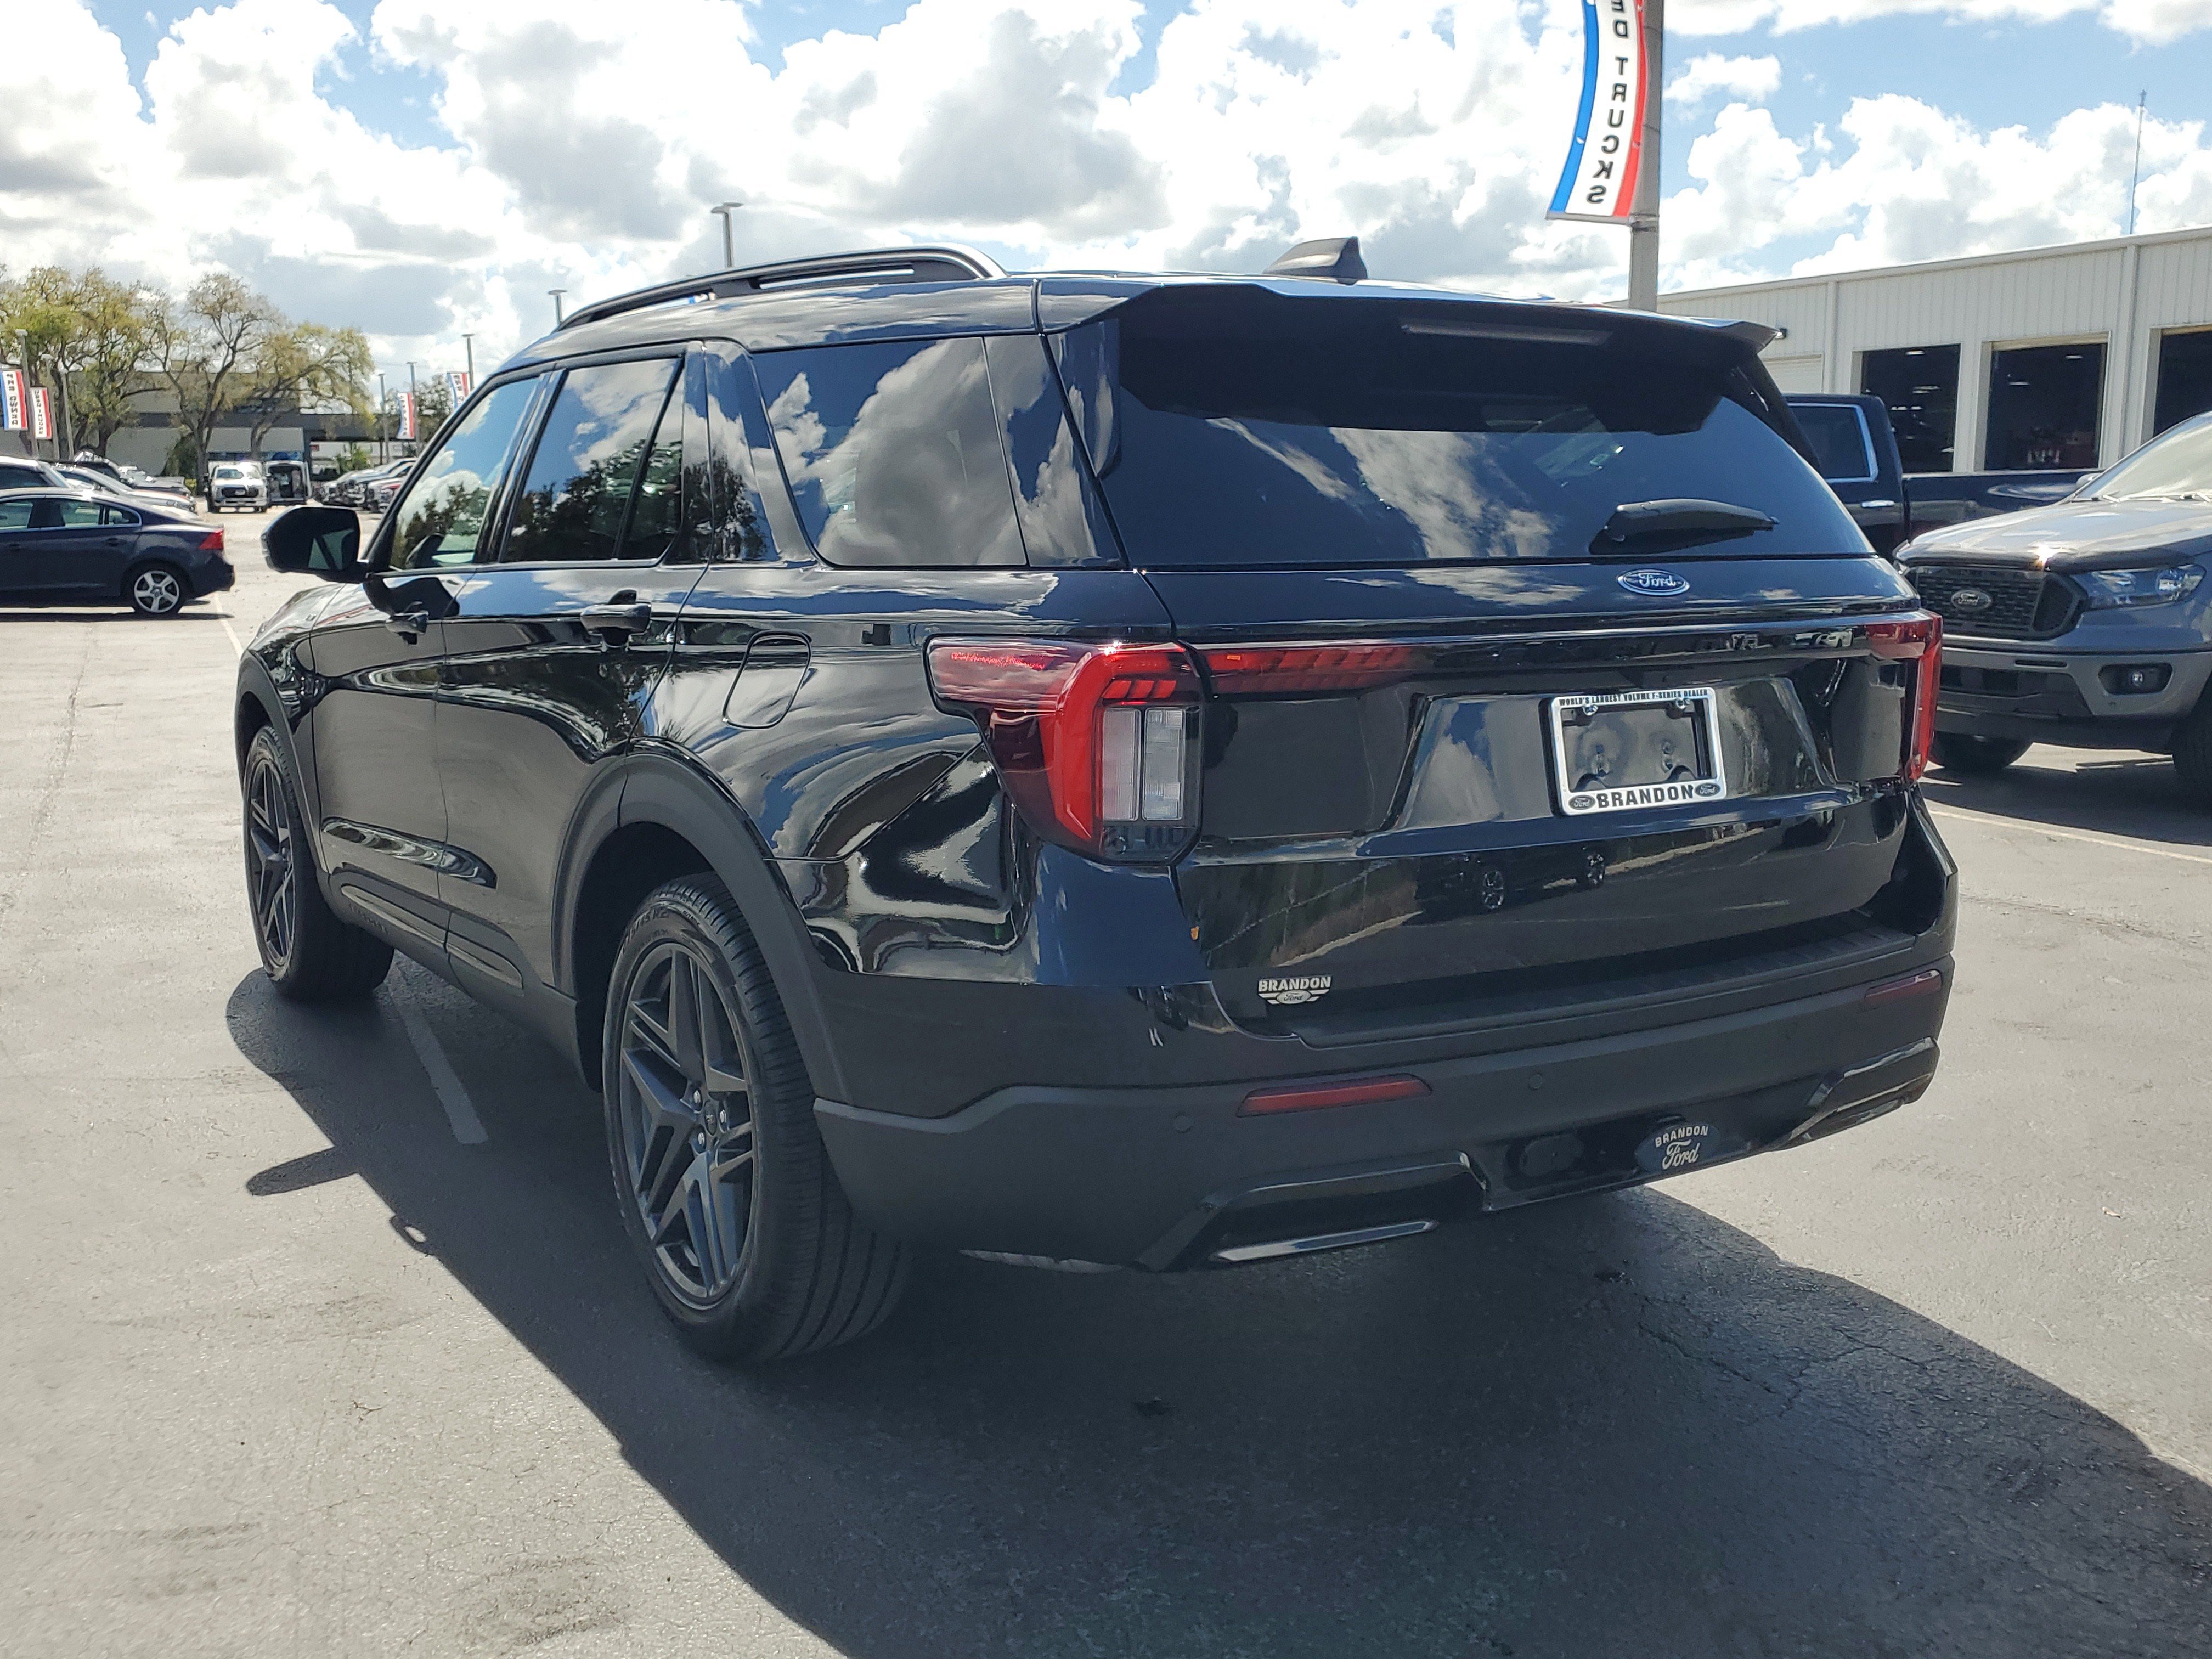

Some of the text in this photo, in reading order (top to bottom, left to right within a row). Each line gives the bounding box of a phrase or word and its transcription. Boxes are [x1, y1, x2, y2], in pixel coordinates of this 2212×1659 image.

[1638, 572, 1677, 588] Ford
[1559, 689, 1708, 706] WORLD'S LARGEST VOLUME F-SERIES DEALER
[1573, 784, 1716, 809] Ford BRANDON Ford
[1258, 976, 1331, 992] BRANDON
[1284, 992, 1303, 1001] Ford
[1655, 1125, 1708, 1148] BRANDON
[1662, 1138, 1701, 1170] Ford
